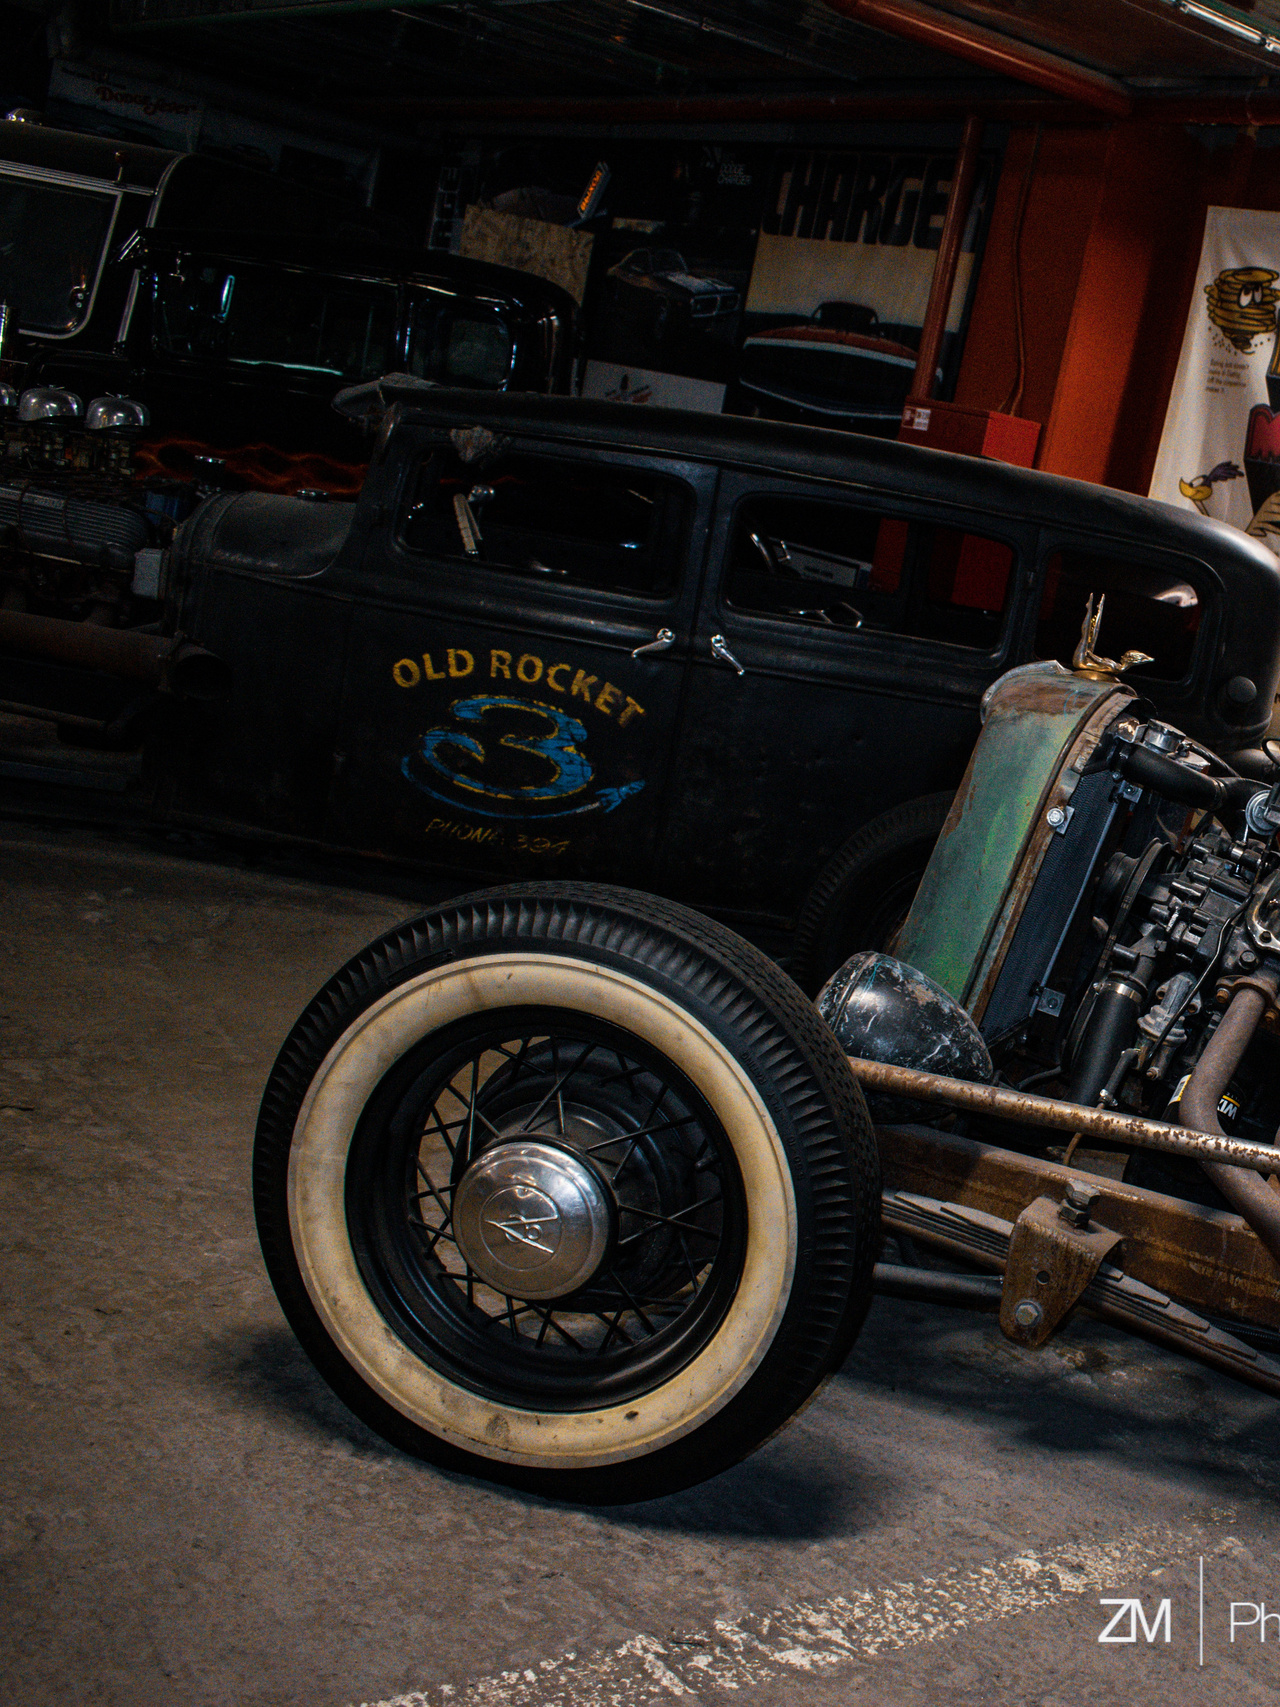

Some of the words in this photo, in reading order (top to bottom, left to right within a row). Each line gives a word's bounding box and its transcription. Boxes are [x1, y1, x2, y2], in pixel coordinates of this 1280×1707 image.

[393, 648, 475, 689] OLD
[489, 649, 646, 729] ROCKET
[418, 694, 595, 801] 3
